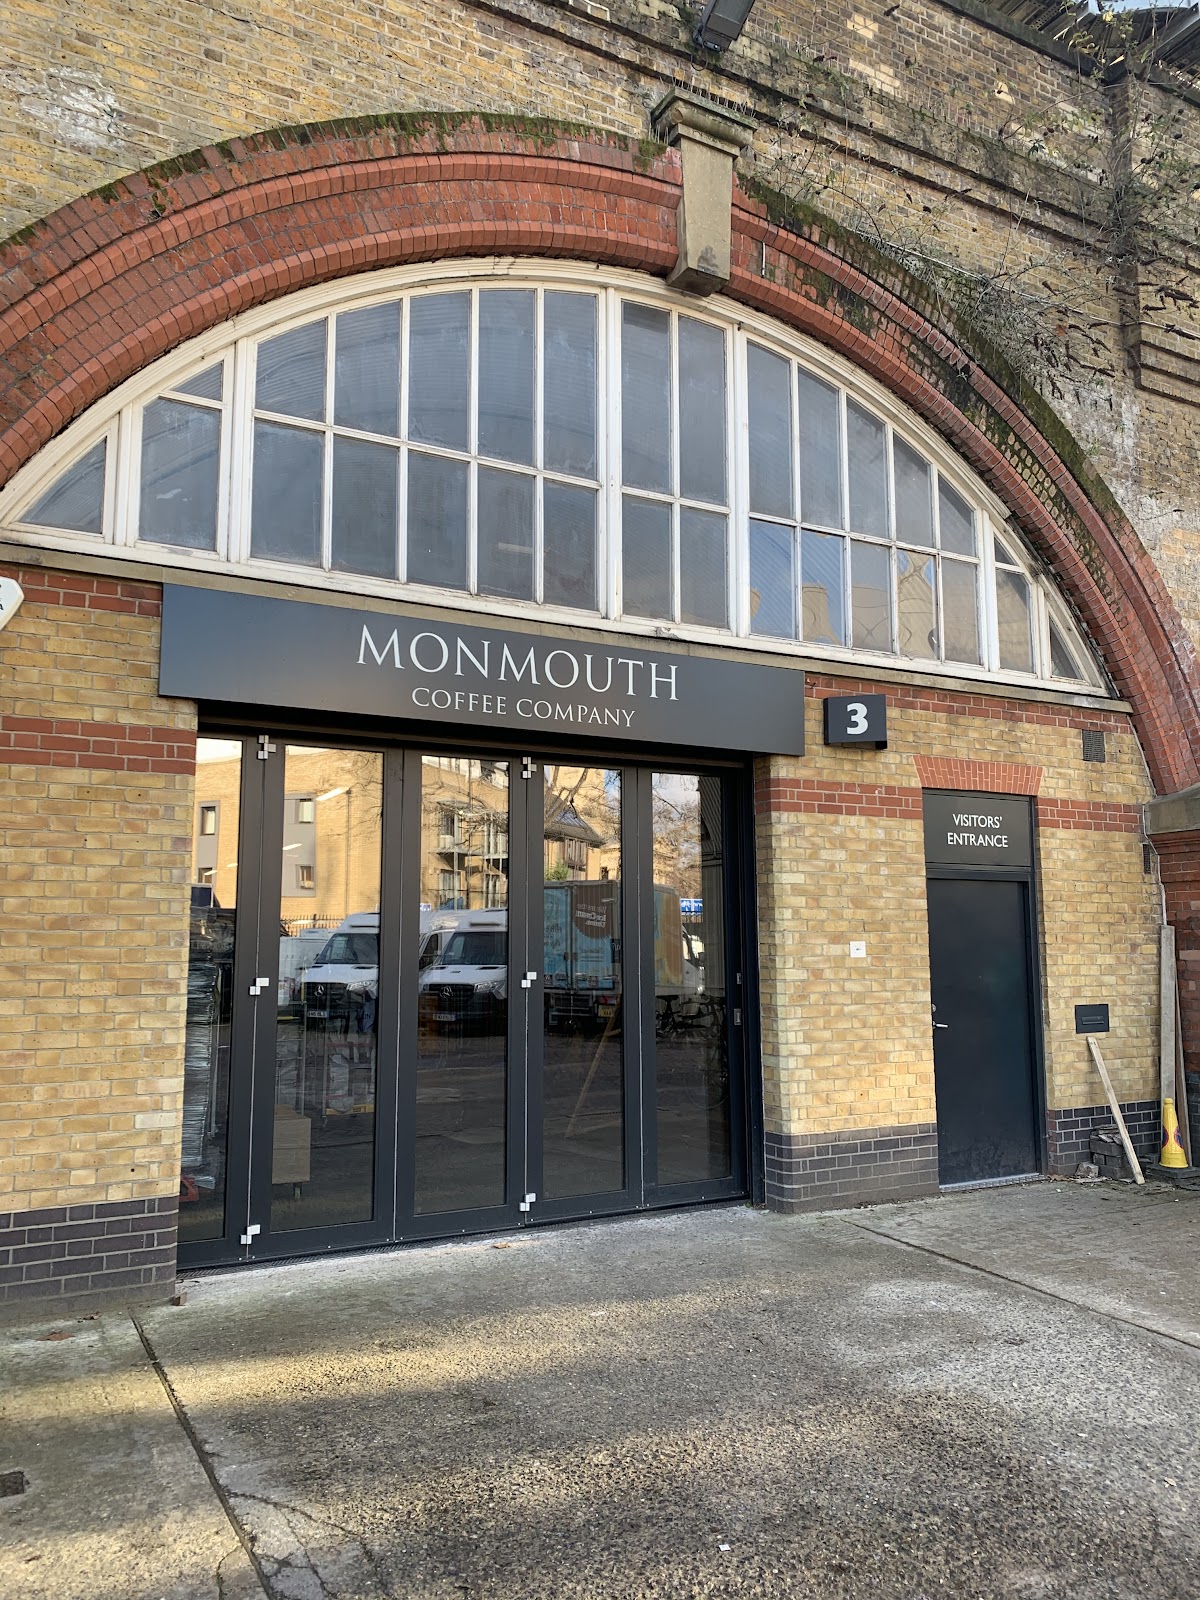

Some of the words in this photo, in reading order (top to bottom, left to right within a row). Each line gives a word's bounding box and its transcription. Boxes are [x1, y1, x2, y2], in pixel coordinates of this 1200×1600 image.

[356, 624, 679, 701] MONMOUTH
[411, 687, 507, 715] COFFEE
[516, 698, 635, 727] COMPANY
[846, 702, 869, 735] 3
[947, 832, 1008, 847] ENTRANCE
